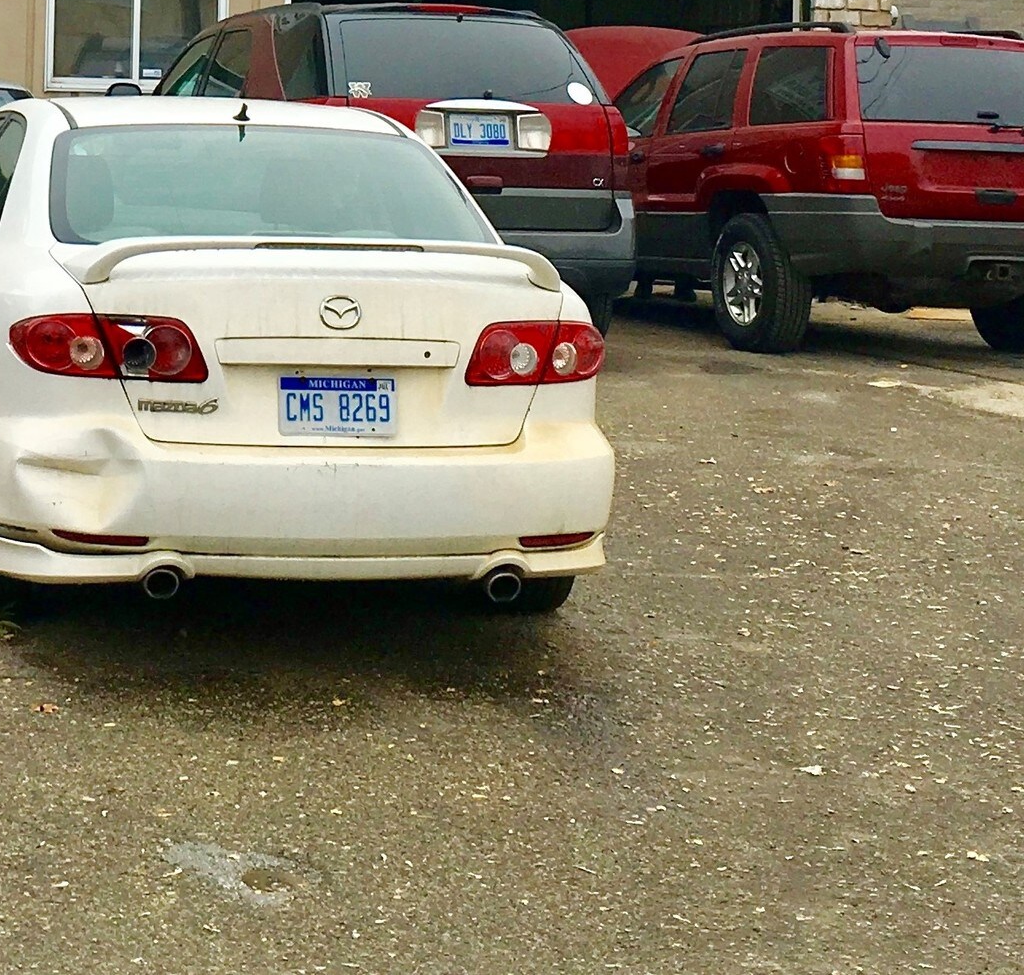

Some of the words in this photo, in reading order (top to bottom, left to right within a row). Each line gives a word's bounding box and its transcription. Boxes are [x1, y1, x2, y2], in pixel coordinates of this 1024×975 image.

[453, 122, 472, 139] DLY
[479, 123, 506, 139] 3080
[308, 379, 367, 390] MICHIGAN
[286, 392, 324, 422] CMS
[339, 393, 391, 423] 8269
